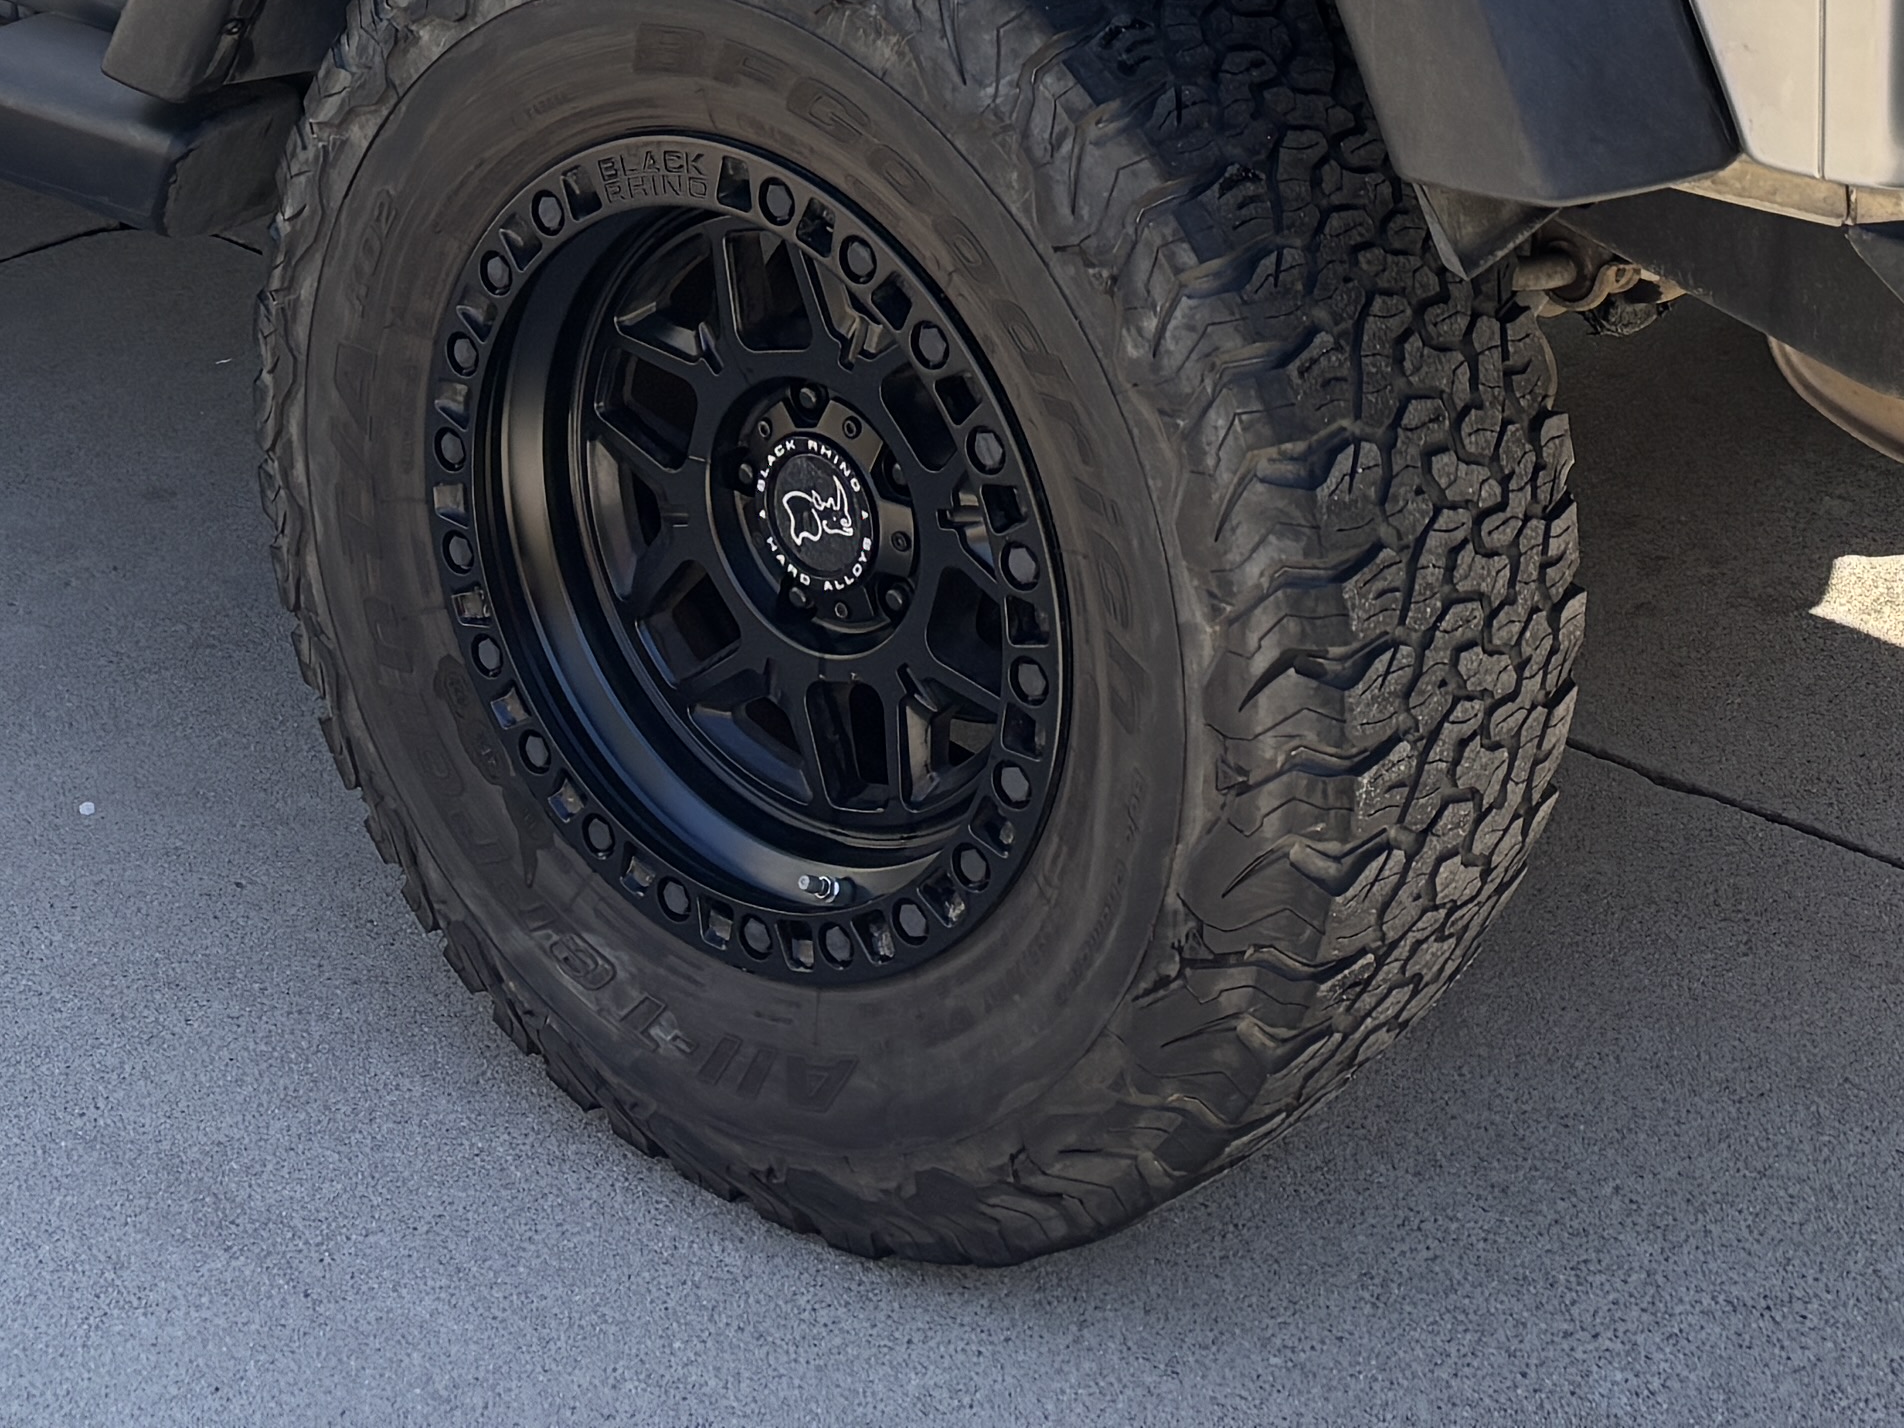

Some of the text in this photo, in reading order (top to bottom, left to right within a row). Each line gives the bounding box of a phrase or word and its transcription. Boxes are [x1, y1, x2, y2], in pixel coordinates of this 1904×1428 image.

[597, 149, 705, 183] BLACK
[604, 174, 708, 204] RHINO
[756, 438, 861, 493] BLACK RHINO
[766, 536, 872, 592] HARD ALLOYS
